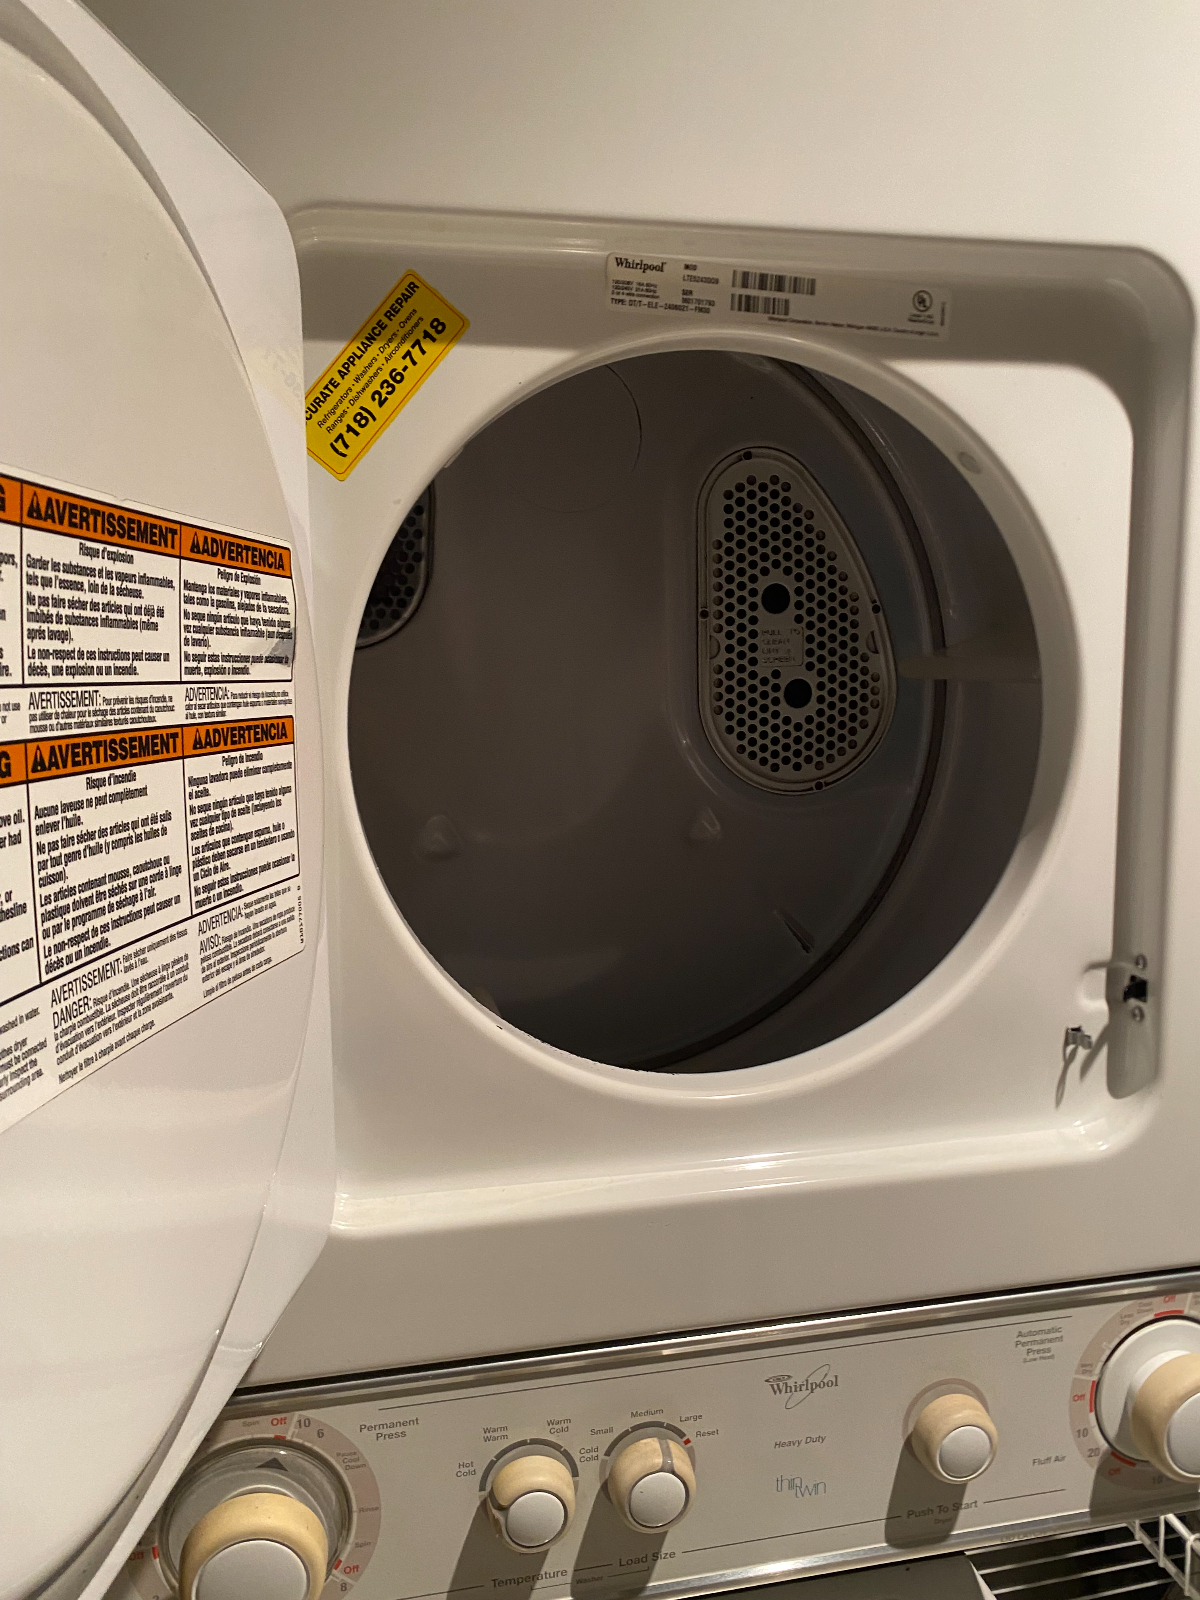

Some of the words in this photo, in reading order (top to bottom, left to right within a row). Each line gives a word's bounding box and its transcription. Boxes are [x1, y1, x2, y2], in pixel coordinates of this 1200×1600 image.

[615, 257, 664, 273] Whirlpool
[305, 377, 341, 424] CURATE
[337, 319, 388, 380] APPLIANCE
[383, 281, 420, 321] REPAIR
[317, 386, 353, 428] Refrigerators
[353, 356, 378, 384] Washers
[378, 331, 398, 354] Dryers
[399, 308, 418, 329] Ovens
[326, 409, 348, 434] Ranges
[349, 366, 383, 407] Dishwashers
[384, 316, 424, 364] Airconditioners
[329, 405, 377, 458] (718)
[371, 317, 446, 408] 236-7718
[43, 496, 178, 549] AVERTISSEMENT
[79, 541, 100, 560] Risque
[101, 546, 135, 565] d'explosion
[200, 535, 285, 571] ADVERTENCIA
[26, 553, 50, 571] Garder
[51, 558, 61, 573] les
[62, 561, 97, 579] substances
[97, 566, 104, 579] et
[105, 567, 114, 580] les
[114, 571, 137, 588] vapeurs
[137, 571, 176, 591] inflammables,
[217, 568, 233, 583] Peligro
[234, 571, 240, 582] de
[28, 690, 101, 711] AVERTISSEMENT:
[185, 686, 230, 702] ADVERTENCIA:
[202, 722, 288, 749] ADVERTENCIA
[47, 732, 179, 771] AVERTISSEMENT
[222, 755, 238, 767] Peligro
[86, 776, 106, 791] Risque
[108, 770, 136, 786] d'incendie
[35, 803, 58, 820] Aucune
[60, 799, 84, 814] laveuse
[86, 798, 93, 808] ne
[95, 792, 108, 809] peut
[109, 785, 148, 804] complètement
[36, 819, 60, 836] enlever
[61, 813, 83, 830] l'huile.
[36, 841, 46, 856] Ne
[48, 839, 59, 856] pas
[60, 835, 75, 851] faire
[77, 829, 96, 848] sécher
[98, 826, 108, 839] des
[109, 820, 130, 836] articles
[131, 817, 140, 833] qui
[141, 815, 149, 828] ont
[150, 812, 158, 824] été
[159, 810, 172, 822] salis
[37, 858, 49, 875] par
[50, 852, 63, 869] tout
[64, 850, 81, 867] genre
[83, 842, 103, 859] d'huile
[104, 839, 110, 855] (y
[111, 833, 134, 851] compris
[135, 828, 143, 844] les
[143, 826, 160, 840] huiles
[161, 824, 167, 836] de
[38, 866, 69, 888] cuisson).
[40, 893, 52, 908] Les
[53, 885, 77, 903] articles
[77, 873, 107, 894] contenant
[107, 867, 132, 884] mousse,
[132, 856, 162, 875] caoutchouc
[163, 855, 170, 866] ou
[5, 889, 13, 902] or
[41, 902, 71, 927] plastique
[71, 896, 95, 912] doivent
[95, 889, 107, 903] être
[107, 881, 128, 898] séchés
[128, 879, 138, 891] sur
[138, 875, 149, 888] une
[149, 869, 164, 884] corde
[169, 864, 182, 878] linge
[42, 927, 51, 940] ou
[51, 922, 63, 939] par
[64, 918, 71, 931] le
[71, 905, 107, 931] programme
[107, 900, 115, 914] de
[115, 892, 139, 911] séchage
[144, 886, 157, 900] l'air.
[197, 905, 244, 936] ADVERTENCIA:
[43, 945, 52, 959] Le
[53, 928, 90, 951] non-respect
[91, 925, 99, 938] de
[99, 922, 110, 935] ces
[110, 909, 143, 931] instructions
[143, 902, 156, 919] peut
[156, 897, 173, 912] causer
[174, 894, 181, 905] un
[21, 937, 34, 952] can
[199, 933, 221, 955] AVISO:
[45, 956, 64, 975] décès
[65, 952, 74, 966] ou
[74, 949, 83, 962] un
[83, 936, 111, 958] incendie.
[51, 957, 123, 1008] AVERTISSEMENT:
[52, 995, 93, 1030] DANGER:
[1016, 1326, 1063, 1338] Automatic
[1015, 1335, 1063, 1348] Permanent
[1026, 1347, 1051, 1356] Press
[769, 1375, 839, 1396] Whirlpool
[1073, 1394, 1085, 1402] Off
[630, 1407, 664, 1419] Medium
[679, 1413, 703, 1423] Large
[270, 1417, 288, 1427] Off
[297, 1418, 311, 1429] 10
[359, 1416, 420, 1433] Permanent
[546, 1417, 572, 1428] Warm
[317, 1428, 325, 1439] 6
[376, 1429, 408, 1441] Press
[482, 1425, 509, 1435] Warm
[549, 1425, 570, 1435] Cold
[590, 1426, 614, 1436] Small
[695, 1428, 720, 1438] Reset
[1076, 1428, 1089, 1438] 10
[483, 1433, 509, 1443] Warm
[773, 1438, 802, 1449] Heavy
[805, 1434, 826, 1445] Duty
[579, 1445, 599, 1455] Cold
[1087, 1447, 1100, 1458] 20
[342, 1456, 360, 1464] Cool
[458, 1461, 475, 1470] Hot
[579, 1454, 599, 1463] Cold
[1032, 1456, 1051, 1466] Fluff
[1054, 1454, 1067, 1464] Air
[345, 1463, 366, 1471] Down
[455, 1468, 477, 1478] Cold
[359, 1505, 380, 1514] Rinse
[907, 1507, 934, 1519] Push
[936, 1504, 949, 1514] To
[952, 1500, 978, 1511] Start
[354, 1540, 372, 1548] Spin
[618, 1553, 649, 1567] Load
[651, 1549, 676, 1562] Size
[343, 1564, 360, 1575] Off
[492, 1567, 568, 1589] Temperature
